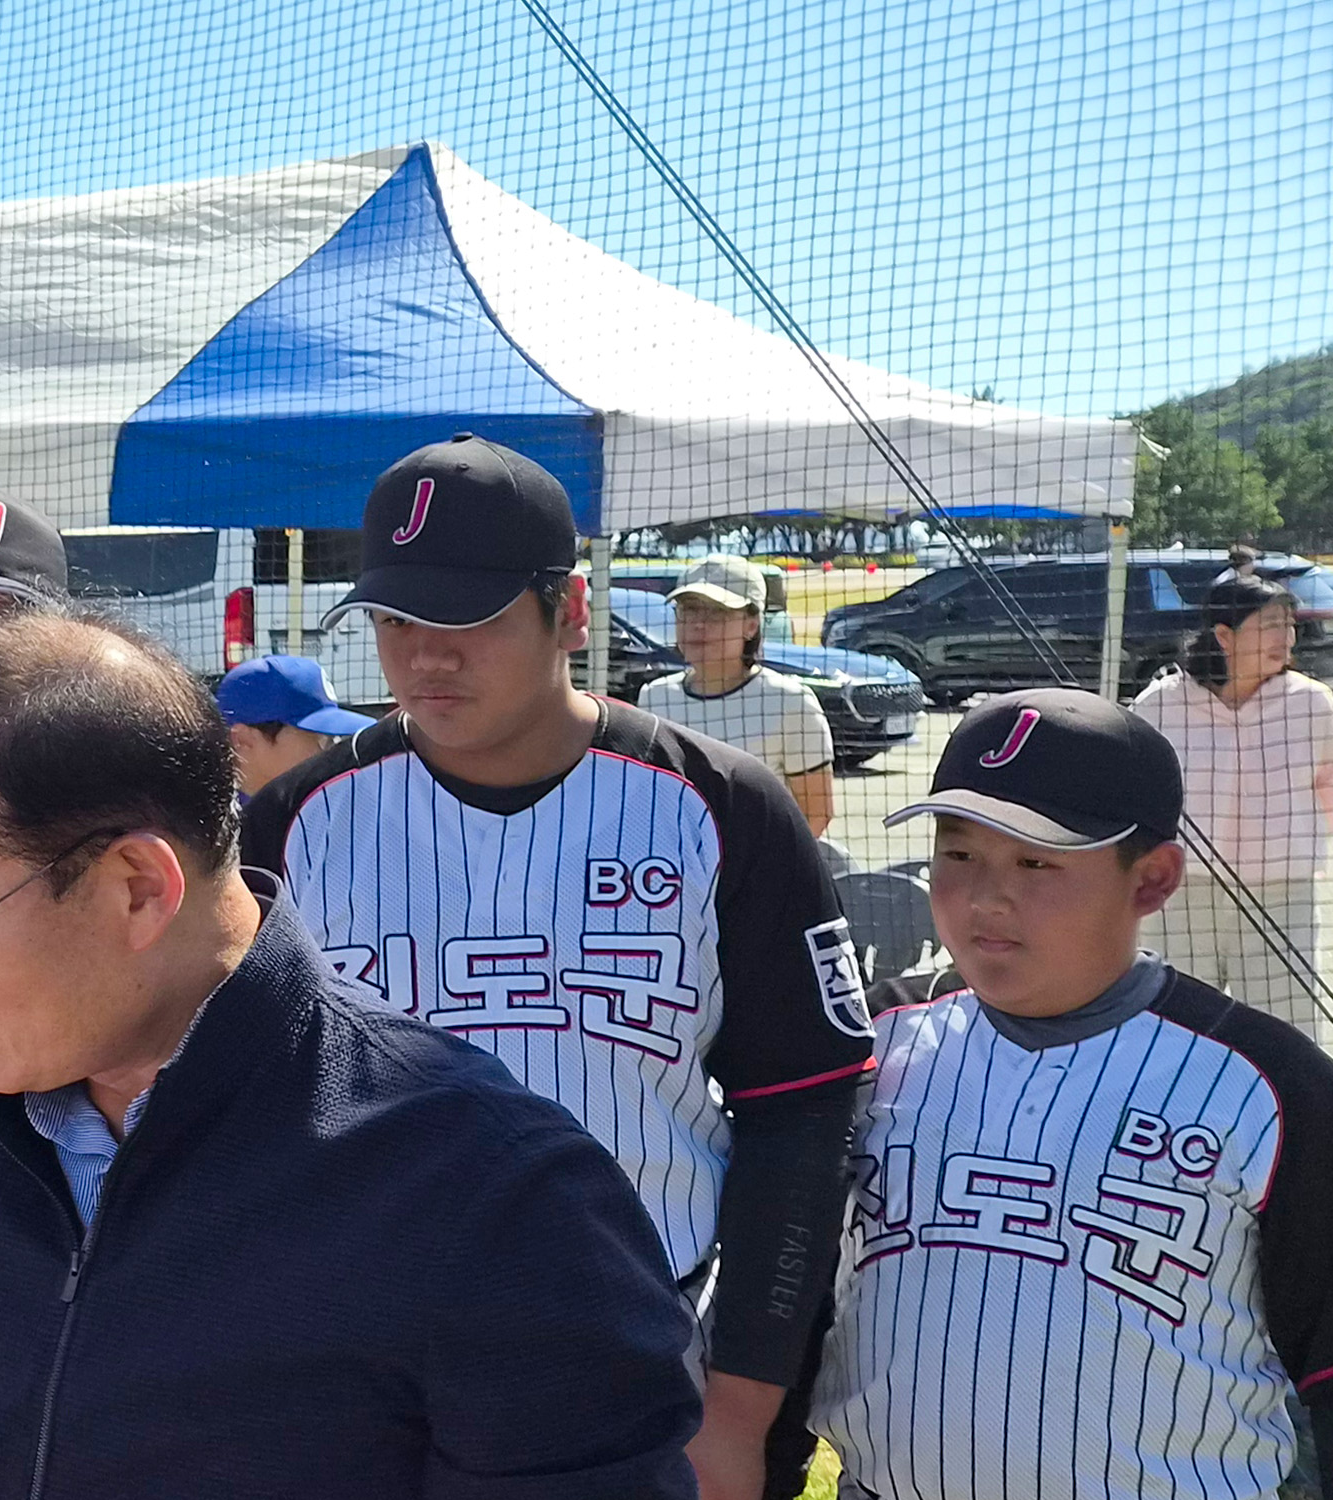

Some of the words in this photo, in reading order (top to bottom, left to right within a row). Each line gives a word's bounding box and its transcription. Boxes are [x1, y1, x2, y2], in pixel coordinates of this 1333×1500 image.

[392, 478, 435, 546] J
[979, 708, 1042, 769] J
[585, 857, 683, 908] BC
[1115, 1107, 1222, 1173] BC
[769, 1223, 810, 1319] FASTER
